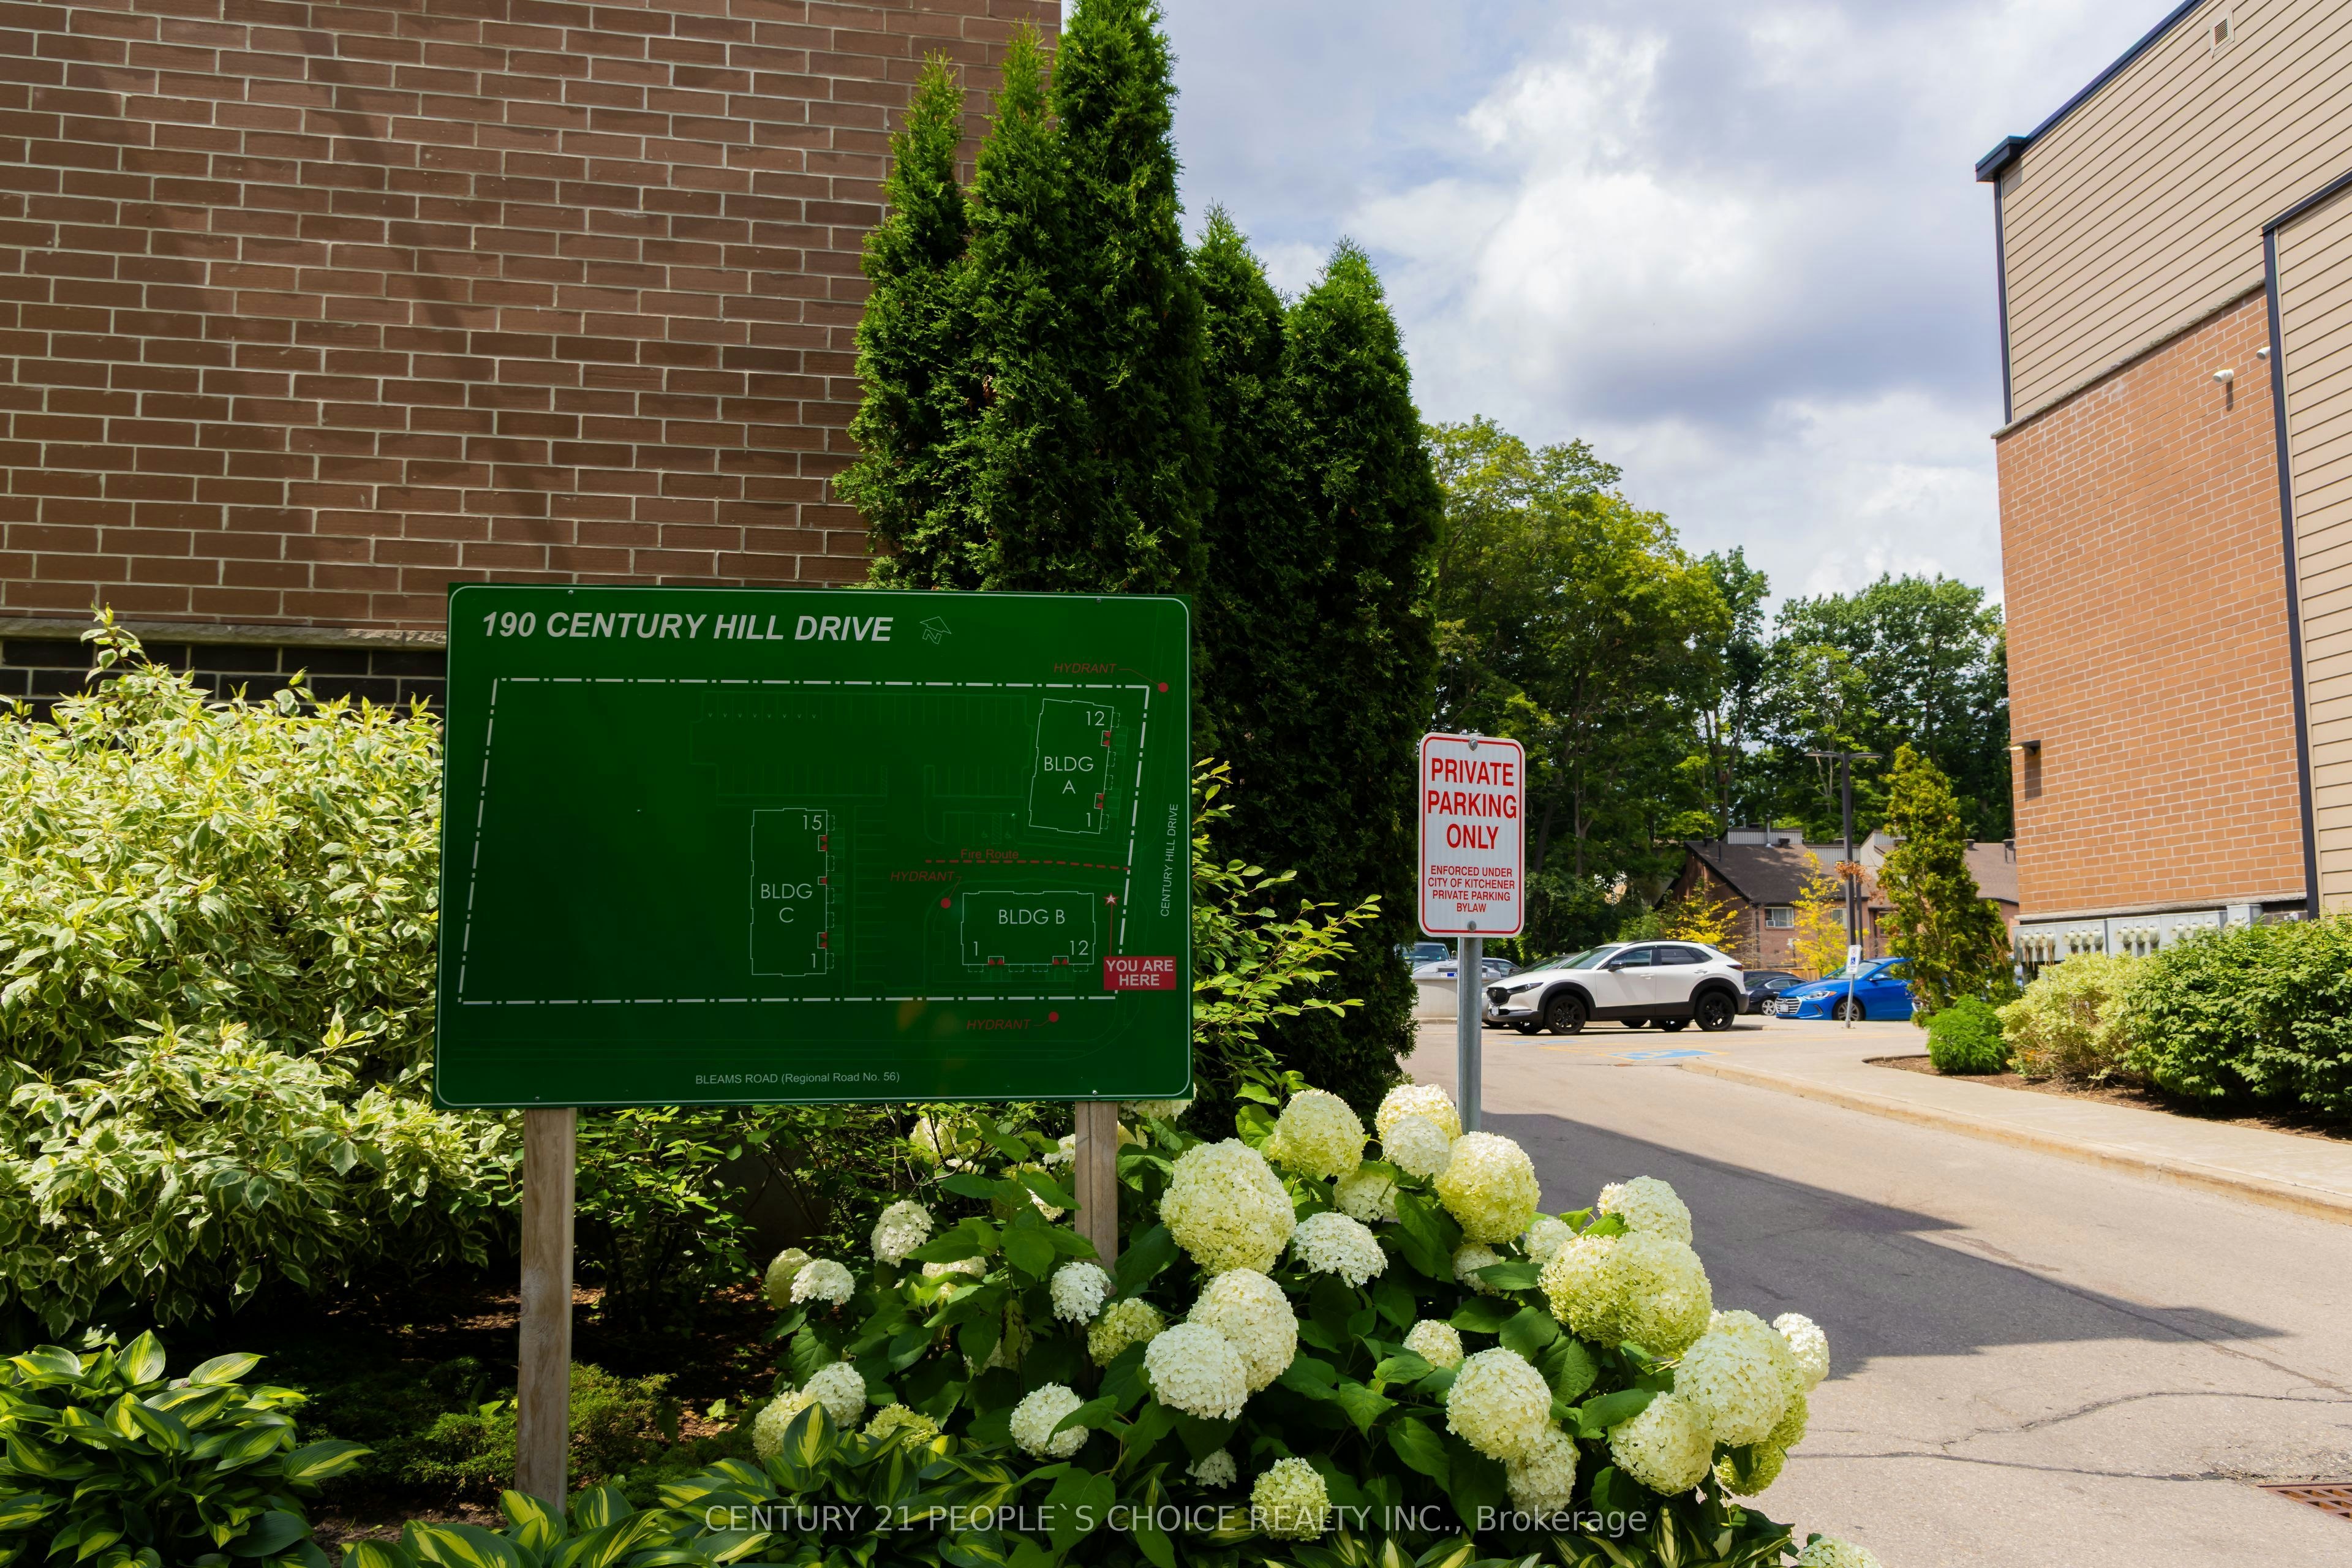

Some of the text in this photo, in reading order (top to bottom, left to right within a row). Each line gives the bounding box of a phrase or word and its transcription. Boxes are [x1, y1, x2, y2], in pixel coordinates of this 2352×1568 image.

[483, 611, 894, 642] 190 CENTURY HILL DRIVE
[1054, 663, 1117, 674] HYDRANT
[1085, 710, 1105, 726] 12
[1044, 756, 1094, 772] BLDG
[1431, 758, 1513, 786] PRIVATE
[1062, 780, 1076, 794] A
[1428, 790, 1517, 819] PARKING
[803, 815, 822, 831] 15
[1086, 813, 1091, 827] 1
[1446, 823, 1499, 850] ONLY
[960, 849, 1019, 859] Fire Route
[1160, 804, 1178, 916] CENTURY HILL DRIVE
[890, 871, 956, 882] HYDRANT
[1431, 865, 1512, 877] ENFORCED UNDER
[1428, 877, 1515, 889] CITY OF KITCHENER
[761, 883, 813, 900] BLDG
[1433, 890, 1510, 901] PRIVATE PARKING
[780, 907, 795, 923] C
[1457, 903, 1487, 912] BYLAW
[998, 909, 1065, 924] BLDG B
[973, 941, 978, 956] 1
[1069, 940, 1088, 956] 12
[811, 953, 815, 968] 1
[1106, 960, 1174, 973] YOU ARE
[1119, 974, 1160, 986] HERE
[966, 1019, 1031, 1030] HYDRANT
[696, 1071, 900, 1084] BLEAMS ROAD (Regional Road No. 56)
